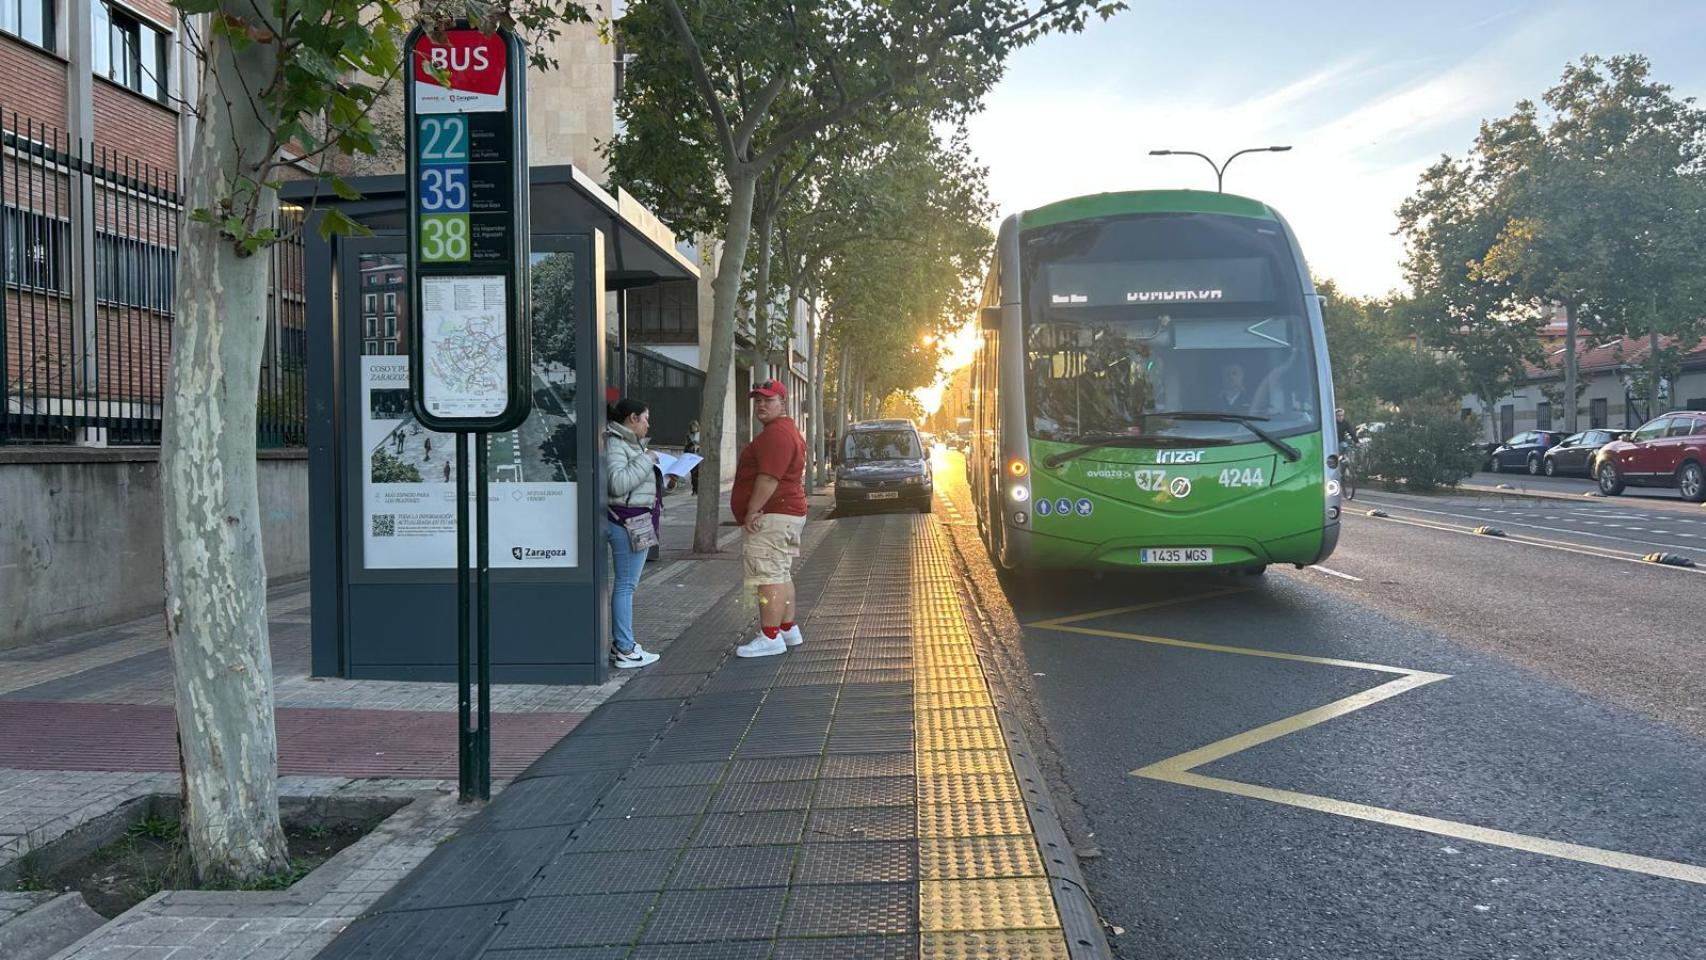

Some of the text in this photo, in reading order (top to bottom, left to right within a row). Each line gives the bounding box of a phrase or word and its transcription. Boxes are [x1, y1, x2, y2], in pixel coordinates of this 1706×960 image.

[431, 46, 489, 71] BUS
[420, 117, 466, 159] 22
[421, 168, 466, 210] 35
[422, 218, 467, 259] 38
[1087, 470, 1122, 478] avanza
[1218, 468, 1264, 487] 4244
[525, 547, 567, 558] Zaragoza
[1152, 549, 1207, 562] 1435 MGS
